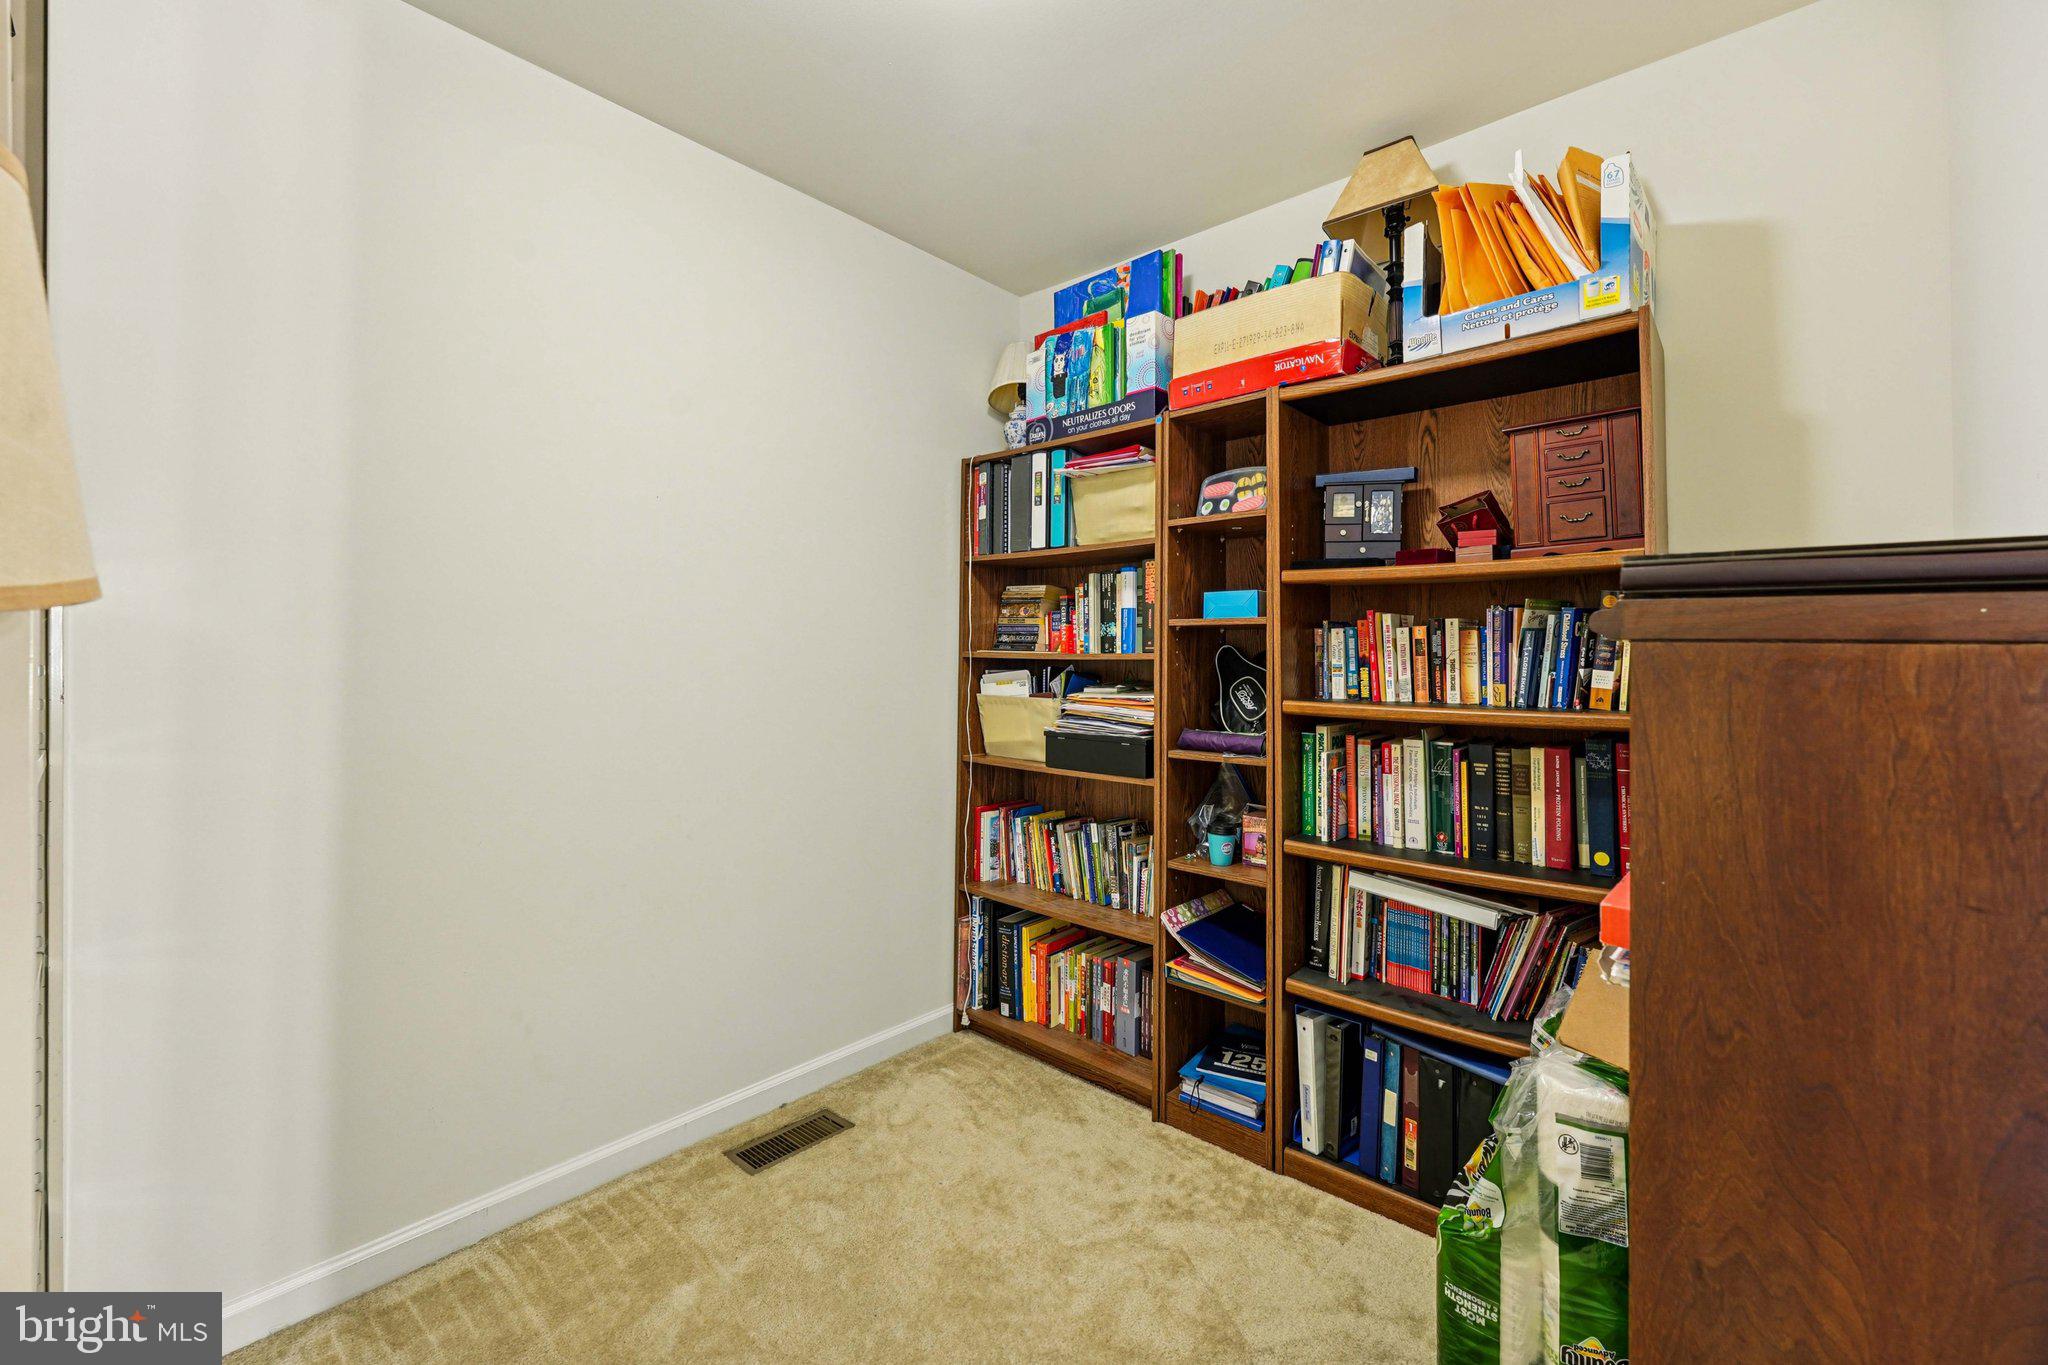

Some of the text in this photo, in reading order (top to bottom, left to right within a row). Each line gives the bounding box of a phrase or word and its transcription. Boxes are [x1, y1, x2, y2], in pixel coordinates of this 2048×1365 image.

[1461, 300, 1559, 332] Nettoie et protège
[1463, 292, 1555, 322] Cleans and Cares
[1408, 332, 1438, 348] Woolite
[1274, 353, 1325, 373] NAVIGATOR
[1062, 401, 1136, 428] NEUTRALIZES ODORS
[1075, 421, 1089, 435] your
[1088, 417, 1112, 429] clothes
[1110, 415, 1120, 424] all
[1118, 412, 1132, 423] day
[1559, 613, 1571, 659] Childhood Stress
[972, 915, 980, 944] UNITED
[1221, 1051, 1267, 1072] 125
[1444, 1286, 1499, 1323] STRENGTH
[1445, 1280, 1492, 1310] ABSORBENCY
[1454, 1303, 1486, 1327] MOST
[1572, 1343, 1617, 1360] Advanced
